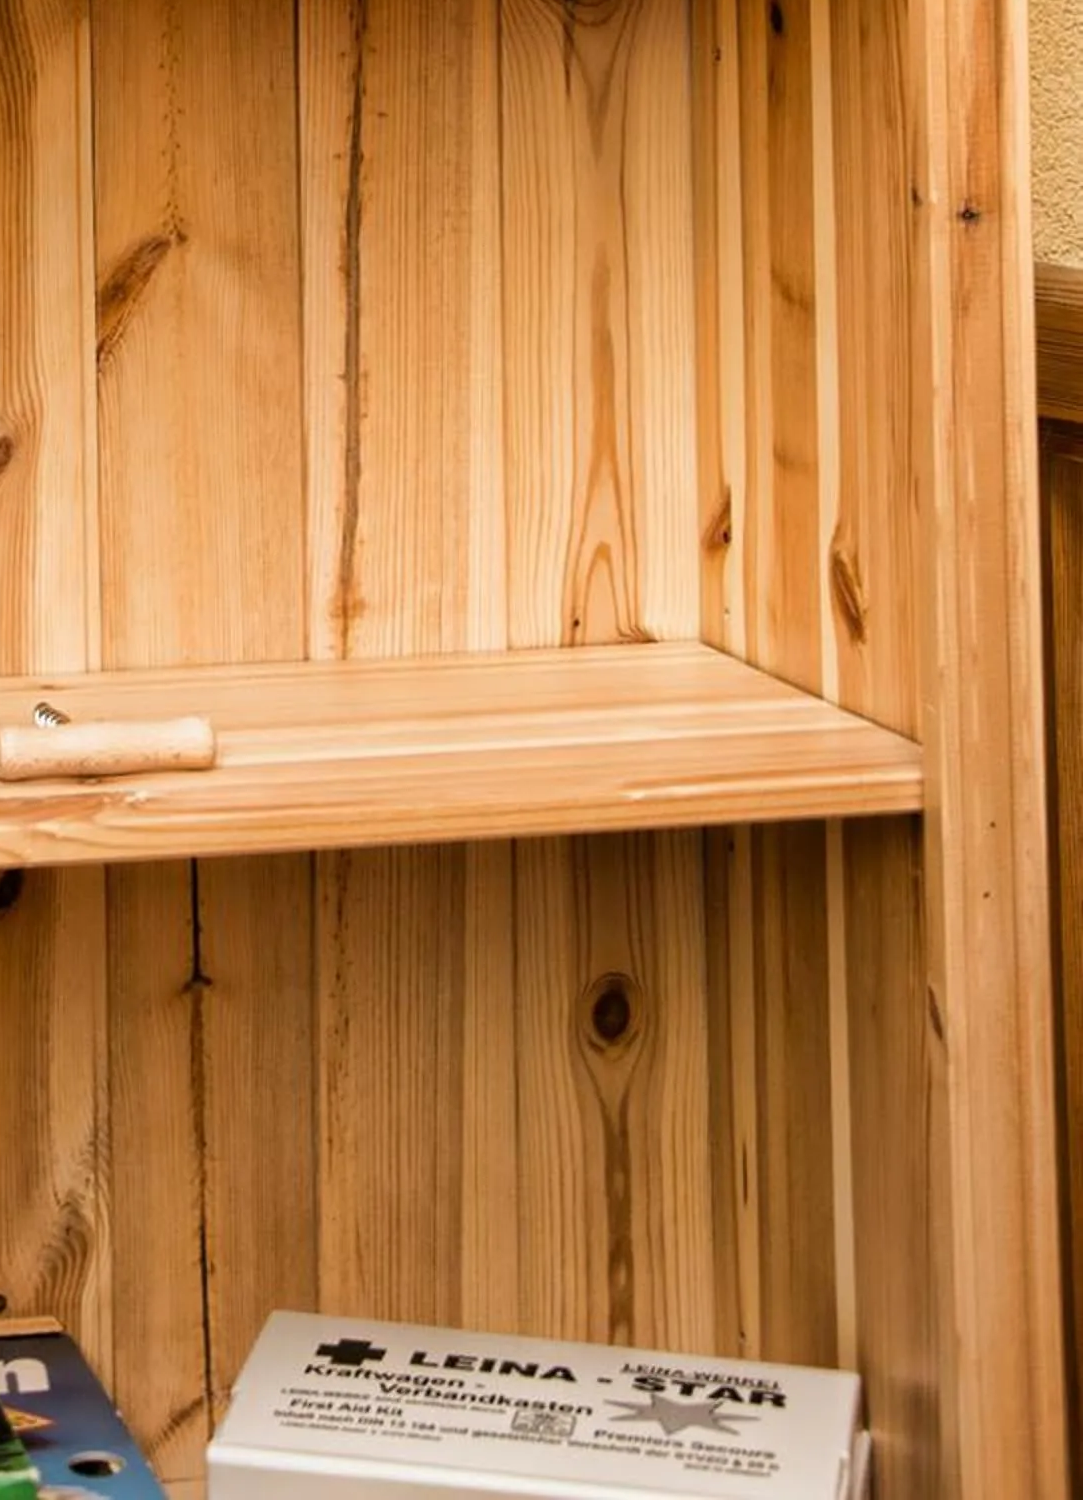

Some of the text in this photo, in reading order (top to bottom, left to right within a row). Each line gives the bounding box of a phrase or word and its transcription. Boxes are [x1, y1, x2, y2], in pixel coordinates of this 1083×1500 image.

[303, 1362, 466, 1390] Kraftwagen
[409, 1350, 578, 1383] LEINA
[631, 1376, 788, 1409] STAR
[289, 1398, 404, 1418] First Aid Kit
[378, 1381, 594, 1417] Verbandkasten
